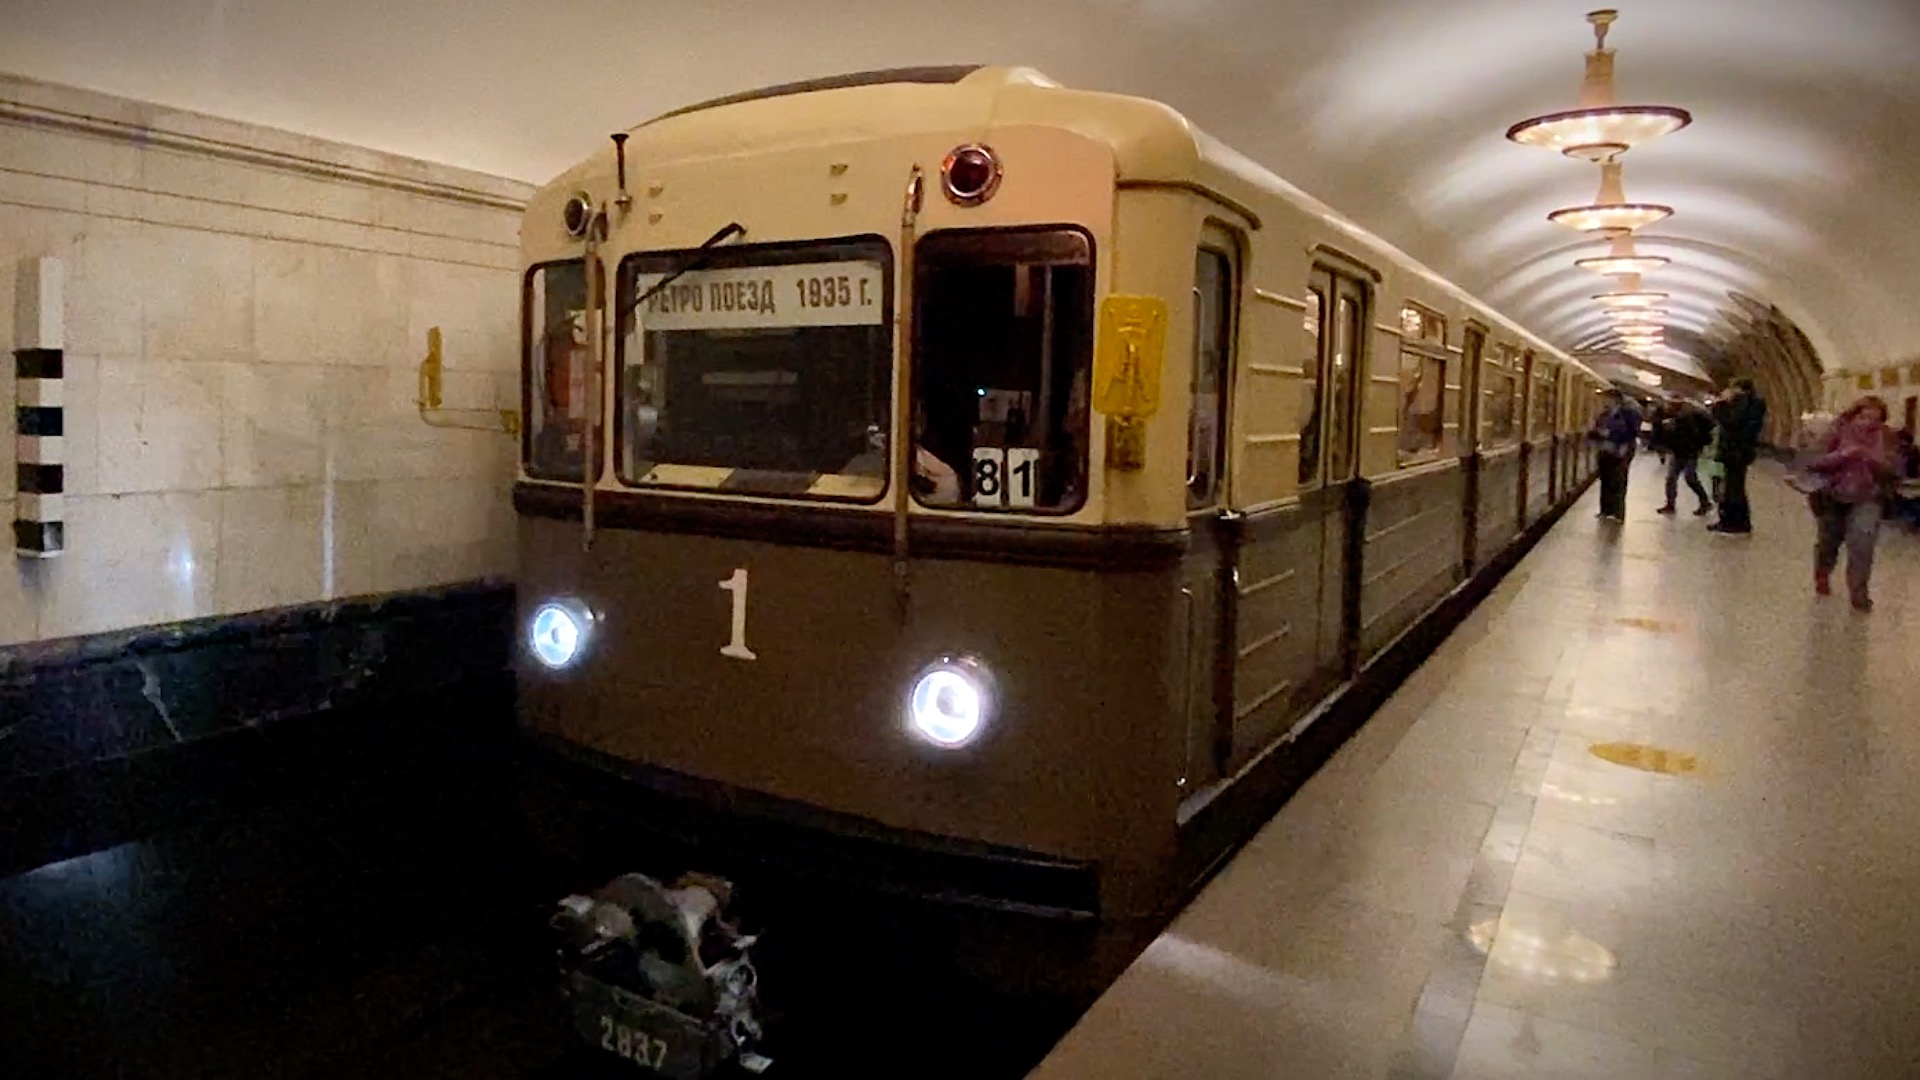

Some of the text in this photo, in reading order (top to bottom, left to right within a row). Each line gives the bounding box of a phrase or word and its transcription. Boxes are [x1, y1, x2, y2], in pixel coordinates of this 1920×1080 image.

[709, 279, 776, 314] ПОЕЗД
[796, 275, 851, 308] 1935
[718, 568, 757, 660] 1
